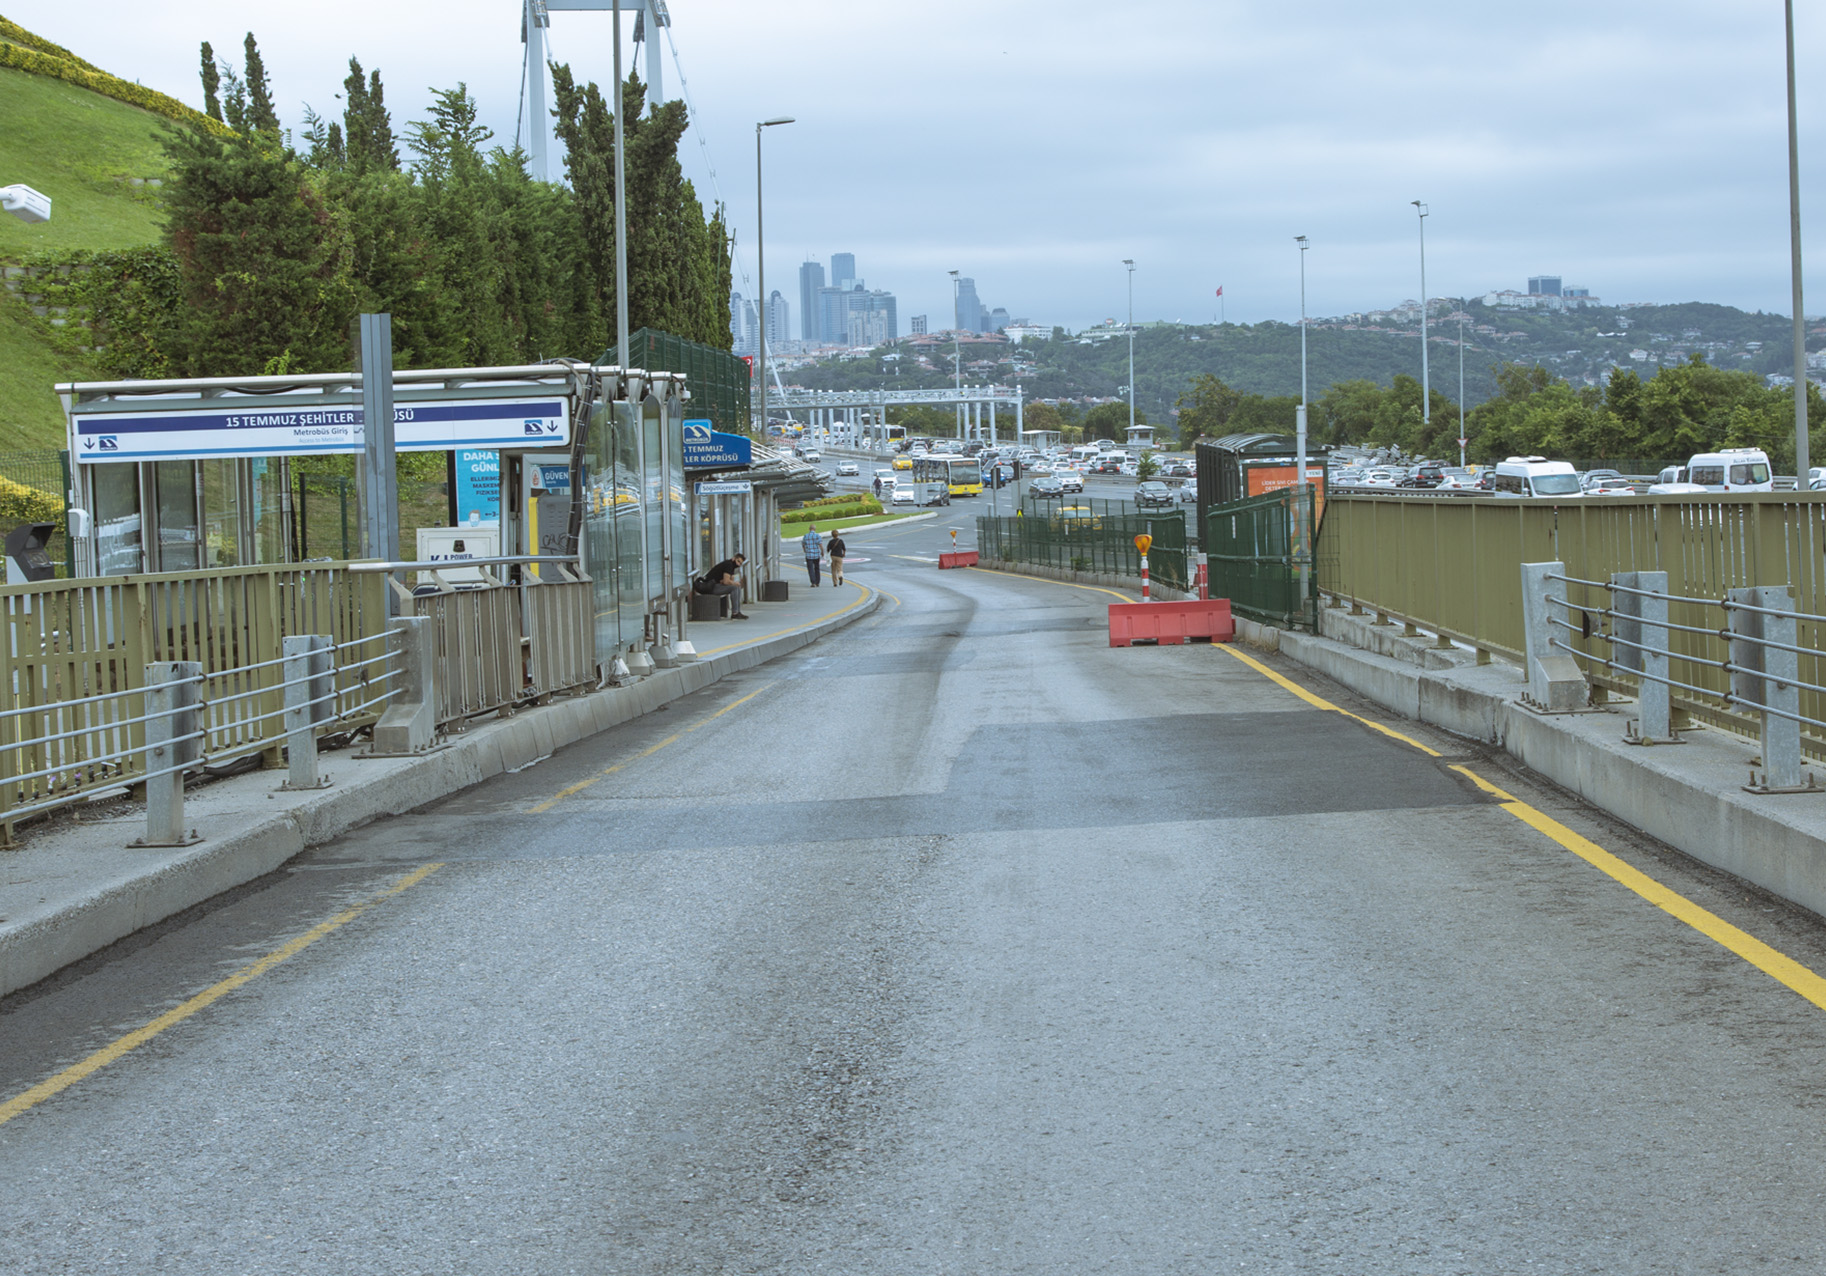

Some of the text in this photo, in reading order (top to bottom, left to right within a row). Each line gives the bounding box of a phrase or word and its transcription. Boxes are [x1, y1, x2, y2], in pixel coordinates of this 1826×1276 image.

[226, 416, 240, 427] 15
[242, 414, 297, 427] TEMMUZ
[299, 411, 355, 427] ŞEHİTLER
[293, 427, 349, 437] Metrobüs Giriş
[463, 452, 494, 461] DAHA
[701, 453, 738, 462] KÖPRÜSÜ
[545, 470, 568, 480] GÜVEN
